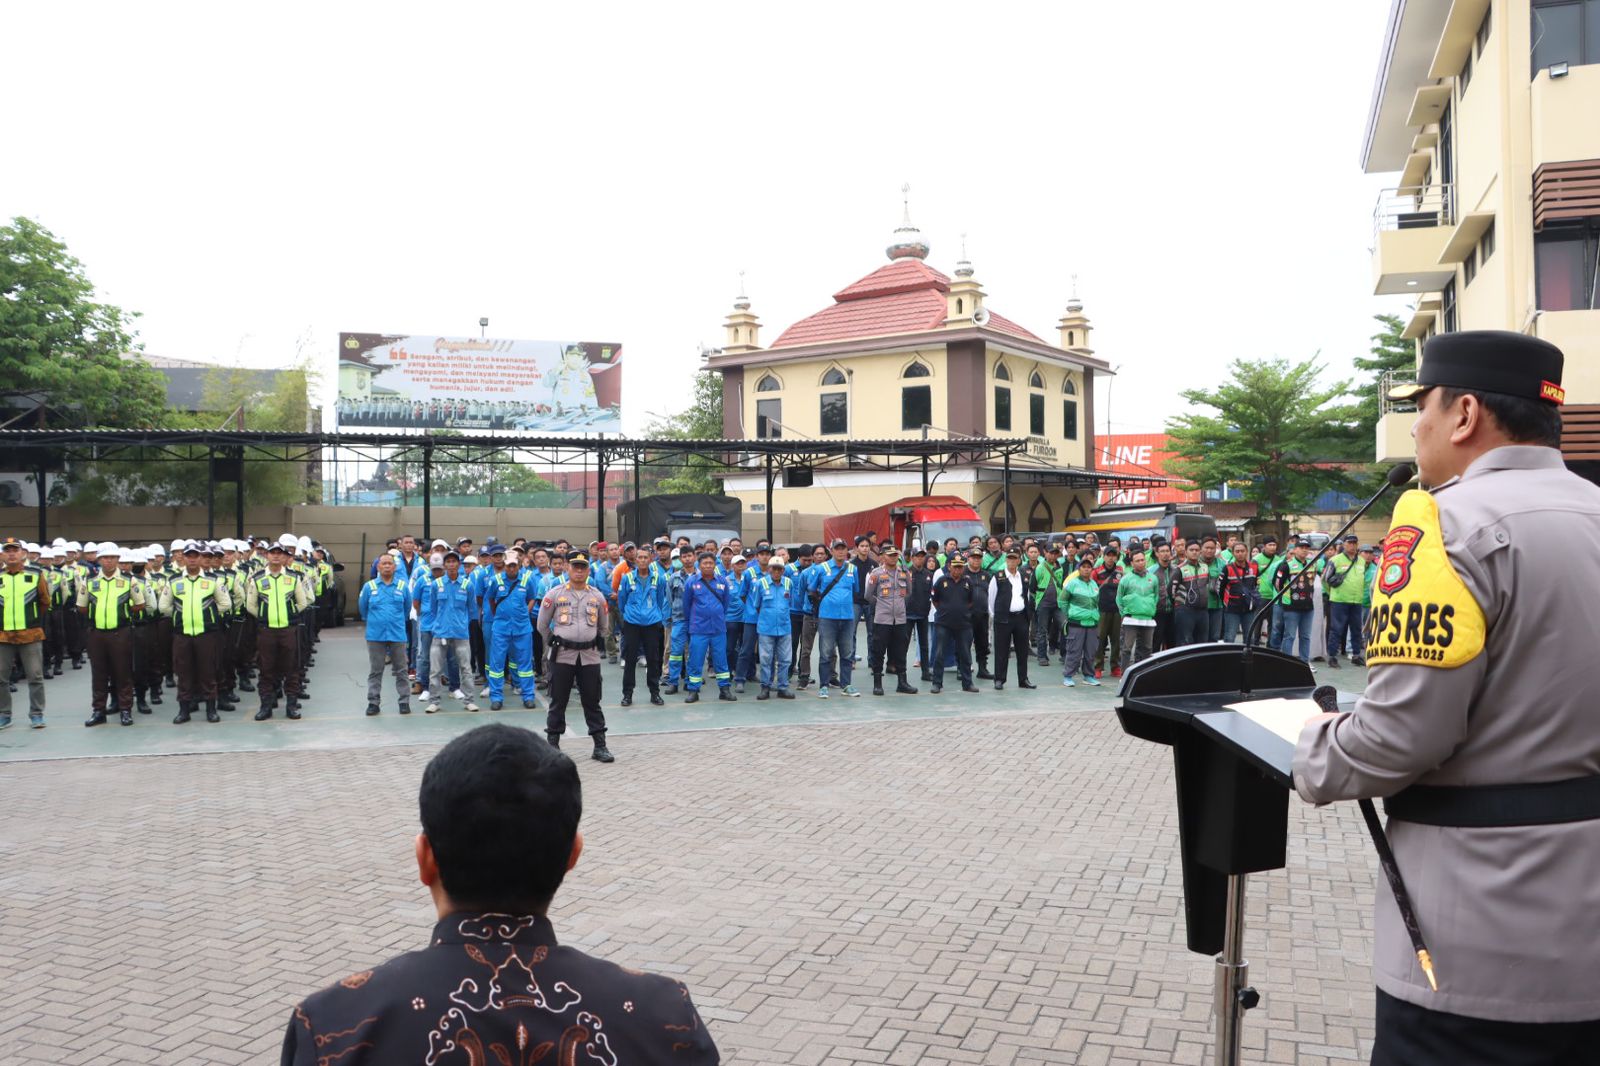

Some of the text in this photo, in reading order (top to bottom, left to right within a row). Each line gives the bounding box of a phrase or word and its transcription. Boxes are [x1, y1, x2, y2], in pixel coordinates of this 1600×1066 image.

[1101, 445, 1153, 465] LINE
[1405, 602, 1455, 648] RES
[1380, 646, 1405, 658] NUSA
[1416, 647, 1445, 661] 2025
